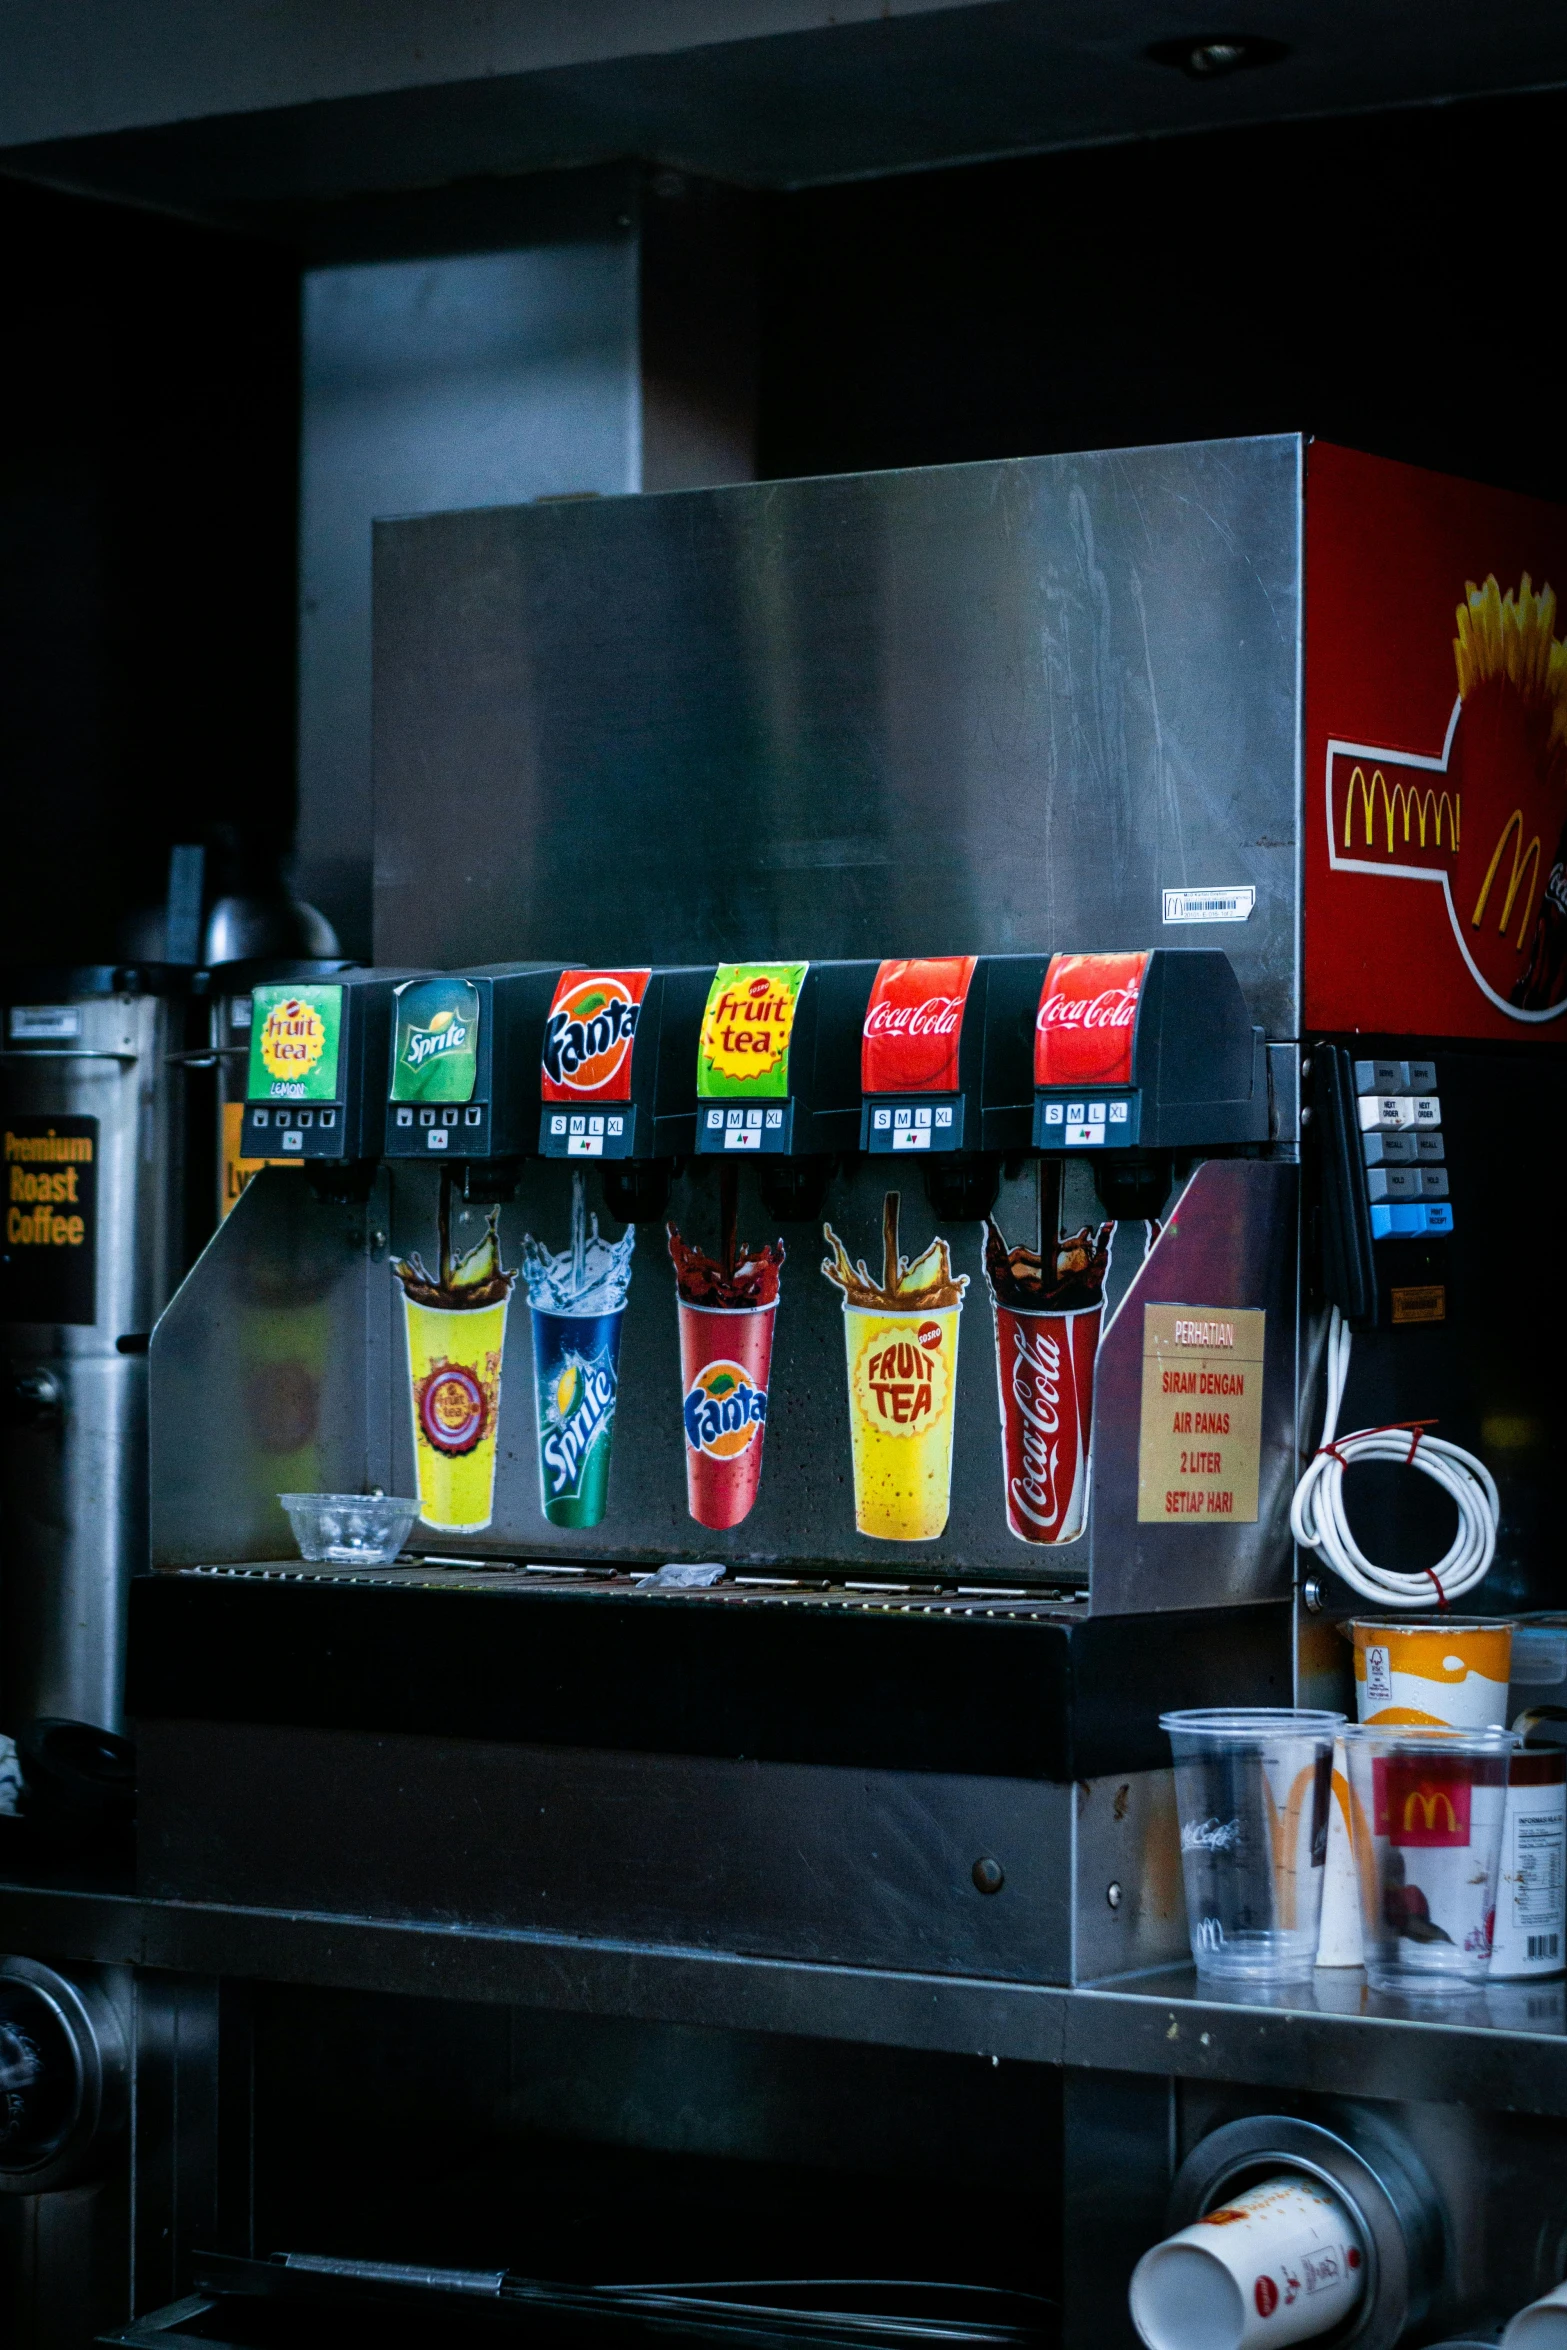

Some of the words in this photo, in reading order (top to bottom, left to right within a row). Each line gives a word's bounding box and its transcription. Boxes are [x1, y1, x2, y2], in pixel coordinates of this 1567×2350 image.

[749, 982, 770, 995] SOSRO
[717, 993, 788, 1024] fruit
[863, 996, 966, 1038] Coca-Cola
[1036, 989, 1140, 1032] Coca-Cola
[267, 1013, 316, 1038] fruit
[407, 1025, 466, 1063] Sprite
[543, 997, 641, 1084] Fanta
[720, 1025, 771, 1053] tea
[273, 1042, 307, 1060] tea
[1414, 1069, 1428, 1078] SERVE
[270, 1081, 306, 1097] LEMON
[1050, 1108, 1059, 1120] S
[1070, 1108, 1081, 1119] M
[1092, 1108, 1100, 1119] L
[1111, 1107, 1126, 1118] XL
[1383, 1109, 1399, 1118] ORDER
[1384, 1101, 1396, 1110] NEXT
[1418, 1110, 1434, 1119] ORDER
[1419, 1102, 1430, 1110] NEXT
[554, 1120, 563, 1132] S
[573, 1120, 583, 1132] M
[592, 1120, 600, 1132] L
[609, 1121, 623, 1132] XL
[711, 1114, 720, 1126] S
[730, 1114, 740, 1125] M
[750, 1114, 757, 1125] L
[766, 1113, 781, 1125] XL
[878, 1114, 887, 1125] S
[898, 1113, 908, 1124] M
[919, 1112, 927, 1124] L
[936, 1111, 951, 1123] XL
[3, 1129, 94, 1163] Premium
[1386, 1141, 1403, 1149] RECALL
[1420, 1141, 1438, 1149] RECALL
[9, 1165, 80, 1203] Roast
[7, 1205, 85, 1245] Coffee
[919, 1327, 941, 1344] SOSRO
[1175, 1320, 1234, 1347] PERHATIAN
[869, 1341, 935, 1381] FRUIT
[1162, 1371, 1196, 1394] SIRAM
[1200, 1373, 1244, 1396] DENGAN
[869, 1382, 932, 1424] TEA
[684, 1383, 767, 1451] Fanta
[1010, 1321, 1060, 1527] Coca-Cola
[1173, 1412, 1192, 1433] AIR
[1195, 1413, 1230, 1434] PANAS
[543, 1368, 612, 1493] Sprite
[1180, 1452, 1187, 1473] 2
[1190, 1452, 1221, 1473] LITER
[1165, 1491, 1204, 1513] SETIAP
[1207, 1491, 1233, 1513] HARI
